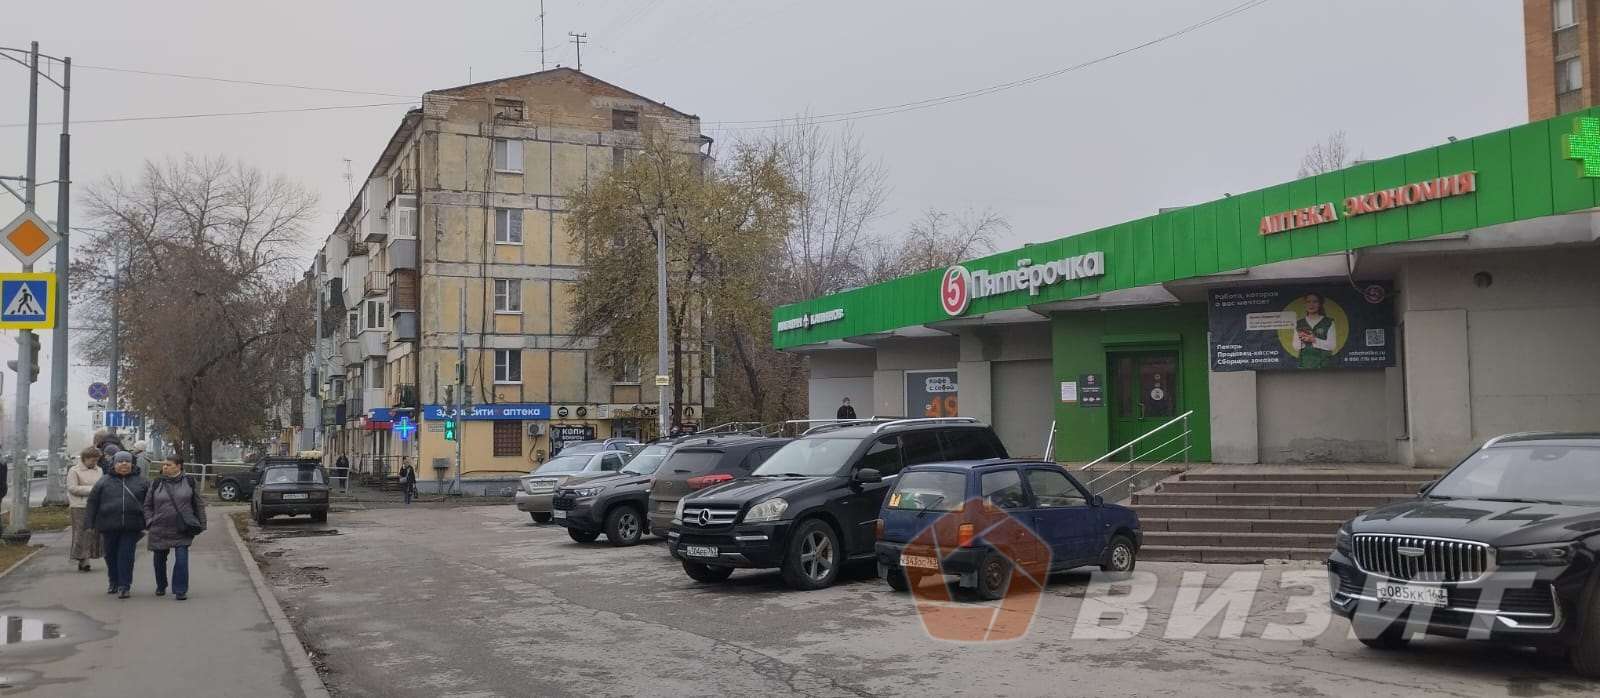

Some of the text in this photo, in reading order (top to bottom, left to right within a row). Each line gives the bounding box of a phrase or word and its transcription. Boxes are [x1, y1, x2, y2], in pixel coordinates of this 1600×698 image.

[1259, 171, 1477, 235] АПТЕКА ЭКОНОМИЯ
[971, 251, 1104, 296] Пятёрочка
[503, 408, 540, 416] аптека
